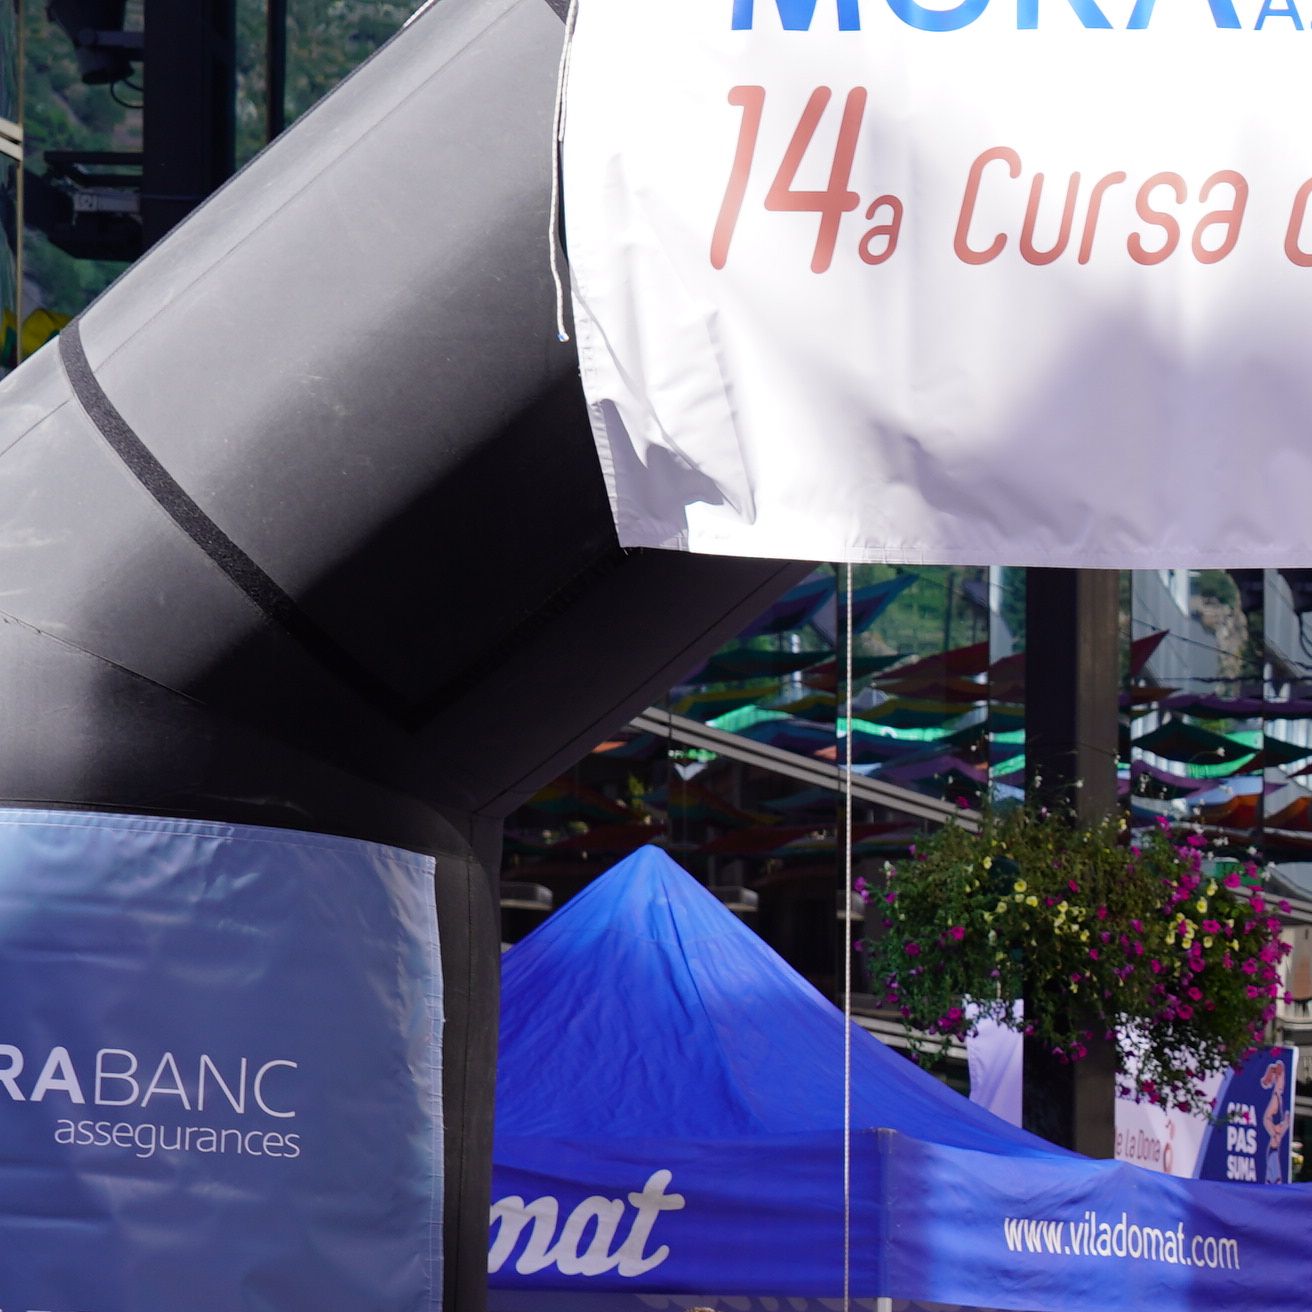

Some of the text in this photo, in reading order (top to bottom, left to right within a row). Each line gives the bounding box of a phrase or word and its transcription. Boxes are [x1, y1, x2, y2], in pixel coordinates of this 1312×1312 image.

[710, 85, 903, 274] 14a
[953, 146, 1249, 267] Cursa
[54, 1119, 301, 1159] assegurances
[1227, 1126, 1257, 1154] PAS
[1004, 1211, 1241, 1270] www.viladomat.com
